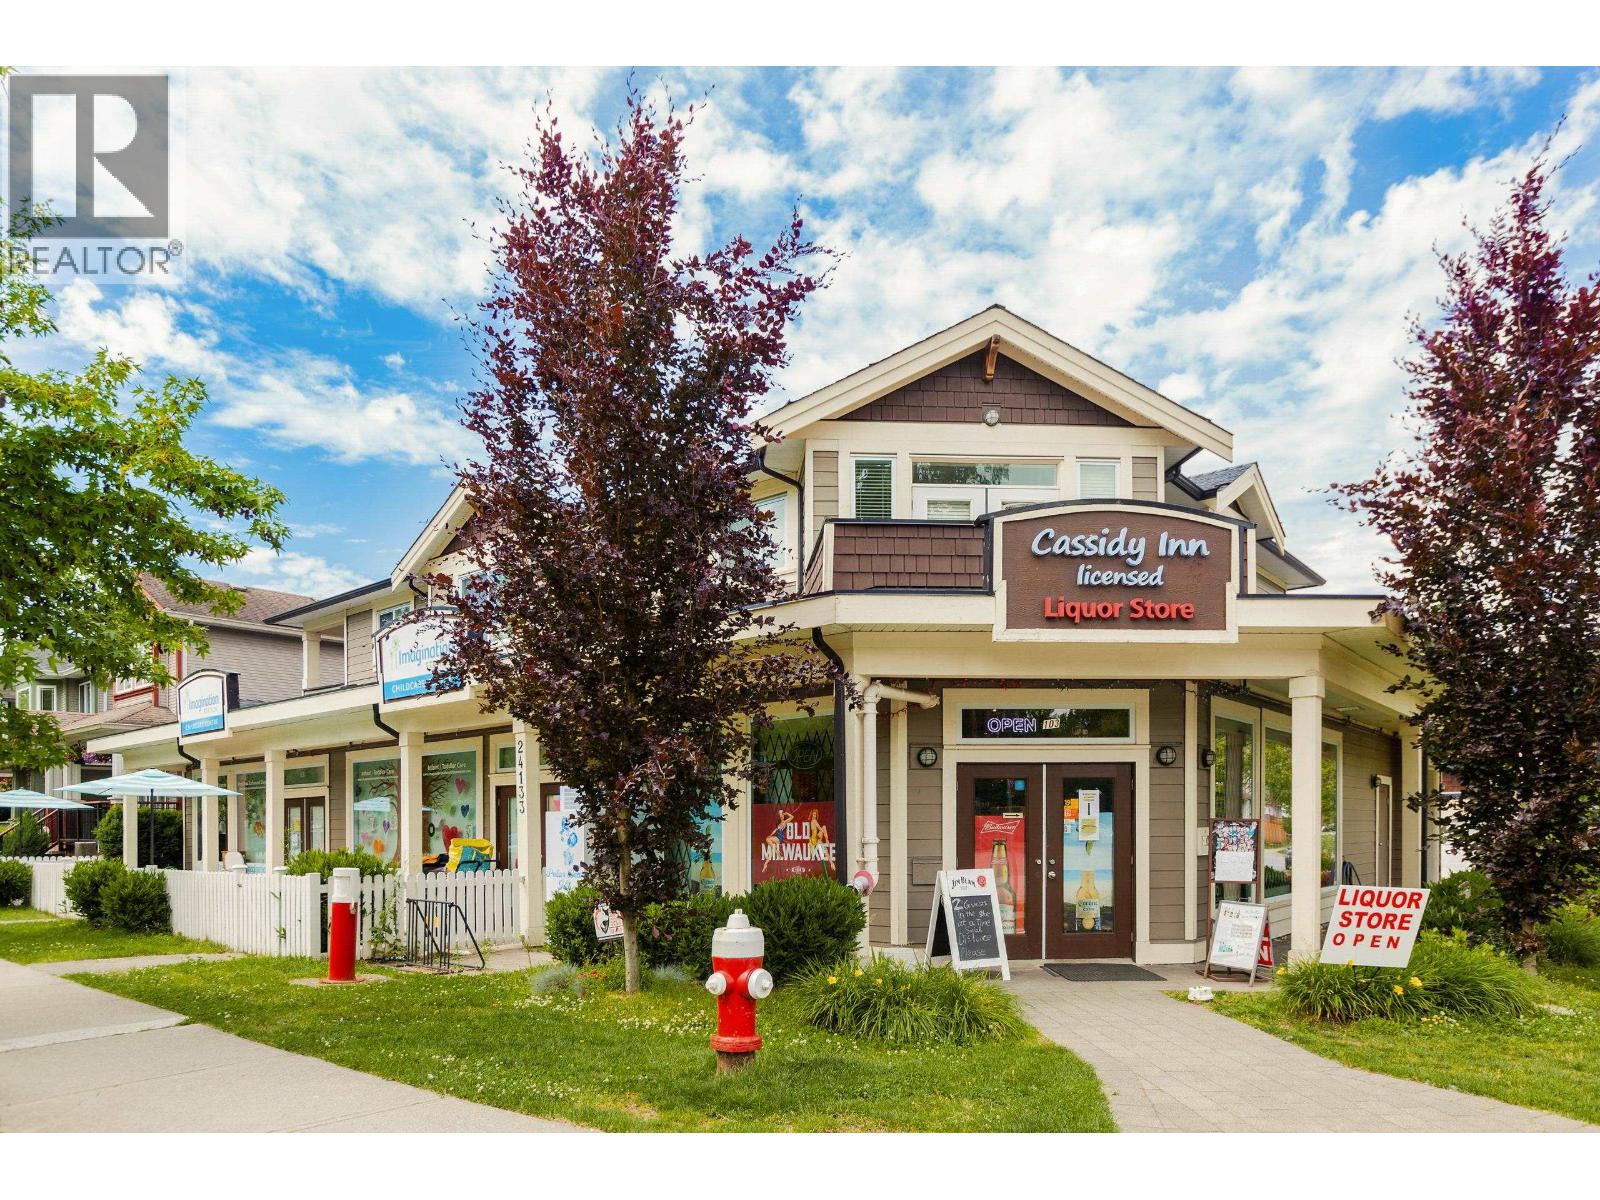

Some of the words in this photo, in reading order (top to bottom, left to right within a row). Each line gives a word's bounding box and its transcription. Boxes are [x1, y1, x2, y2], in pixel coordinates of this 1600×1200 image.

[1031, 527, 1146, 566] Cassidy
[1157, 531, 1210, 557] Inn
[1076, 563, 1164, 586] licensed
[1043, 595, 1123, 624] Liquor
[1129, 598, 1194, 619] Store
[987, 717, 1037, 733] OPEN
[1043, 719, 1060, 730] 103
[517, 739, 526, 814] 24133
[786, 822, 810, 840] OLD
[761, 843, 836, 861] MILWAUKEE
[952, 898, 963, 911] 2
[1338, 889, 1423, 909] LIQUOR
[1338, 911, 1413, 931] STORE
[1332, 933, 1400, 949] OPEN
